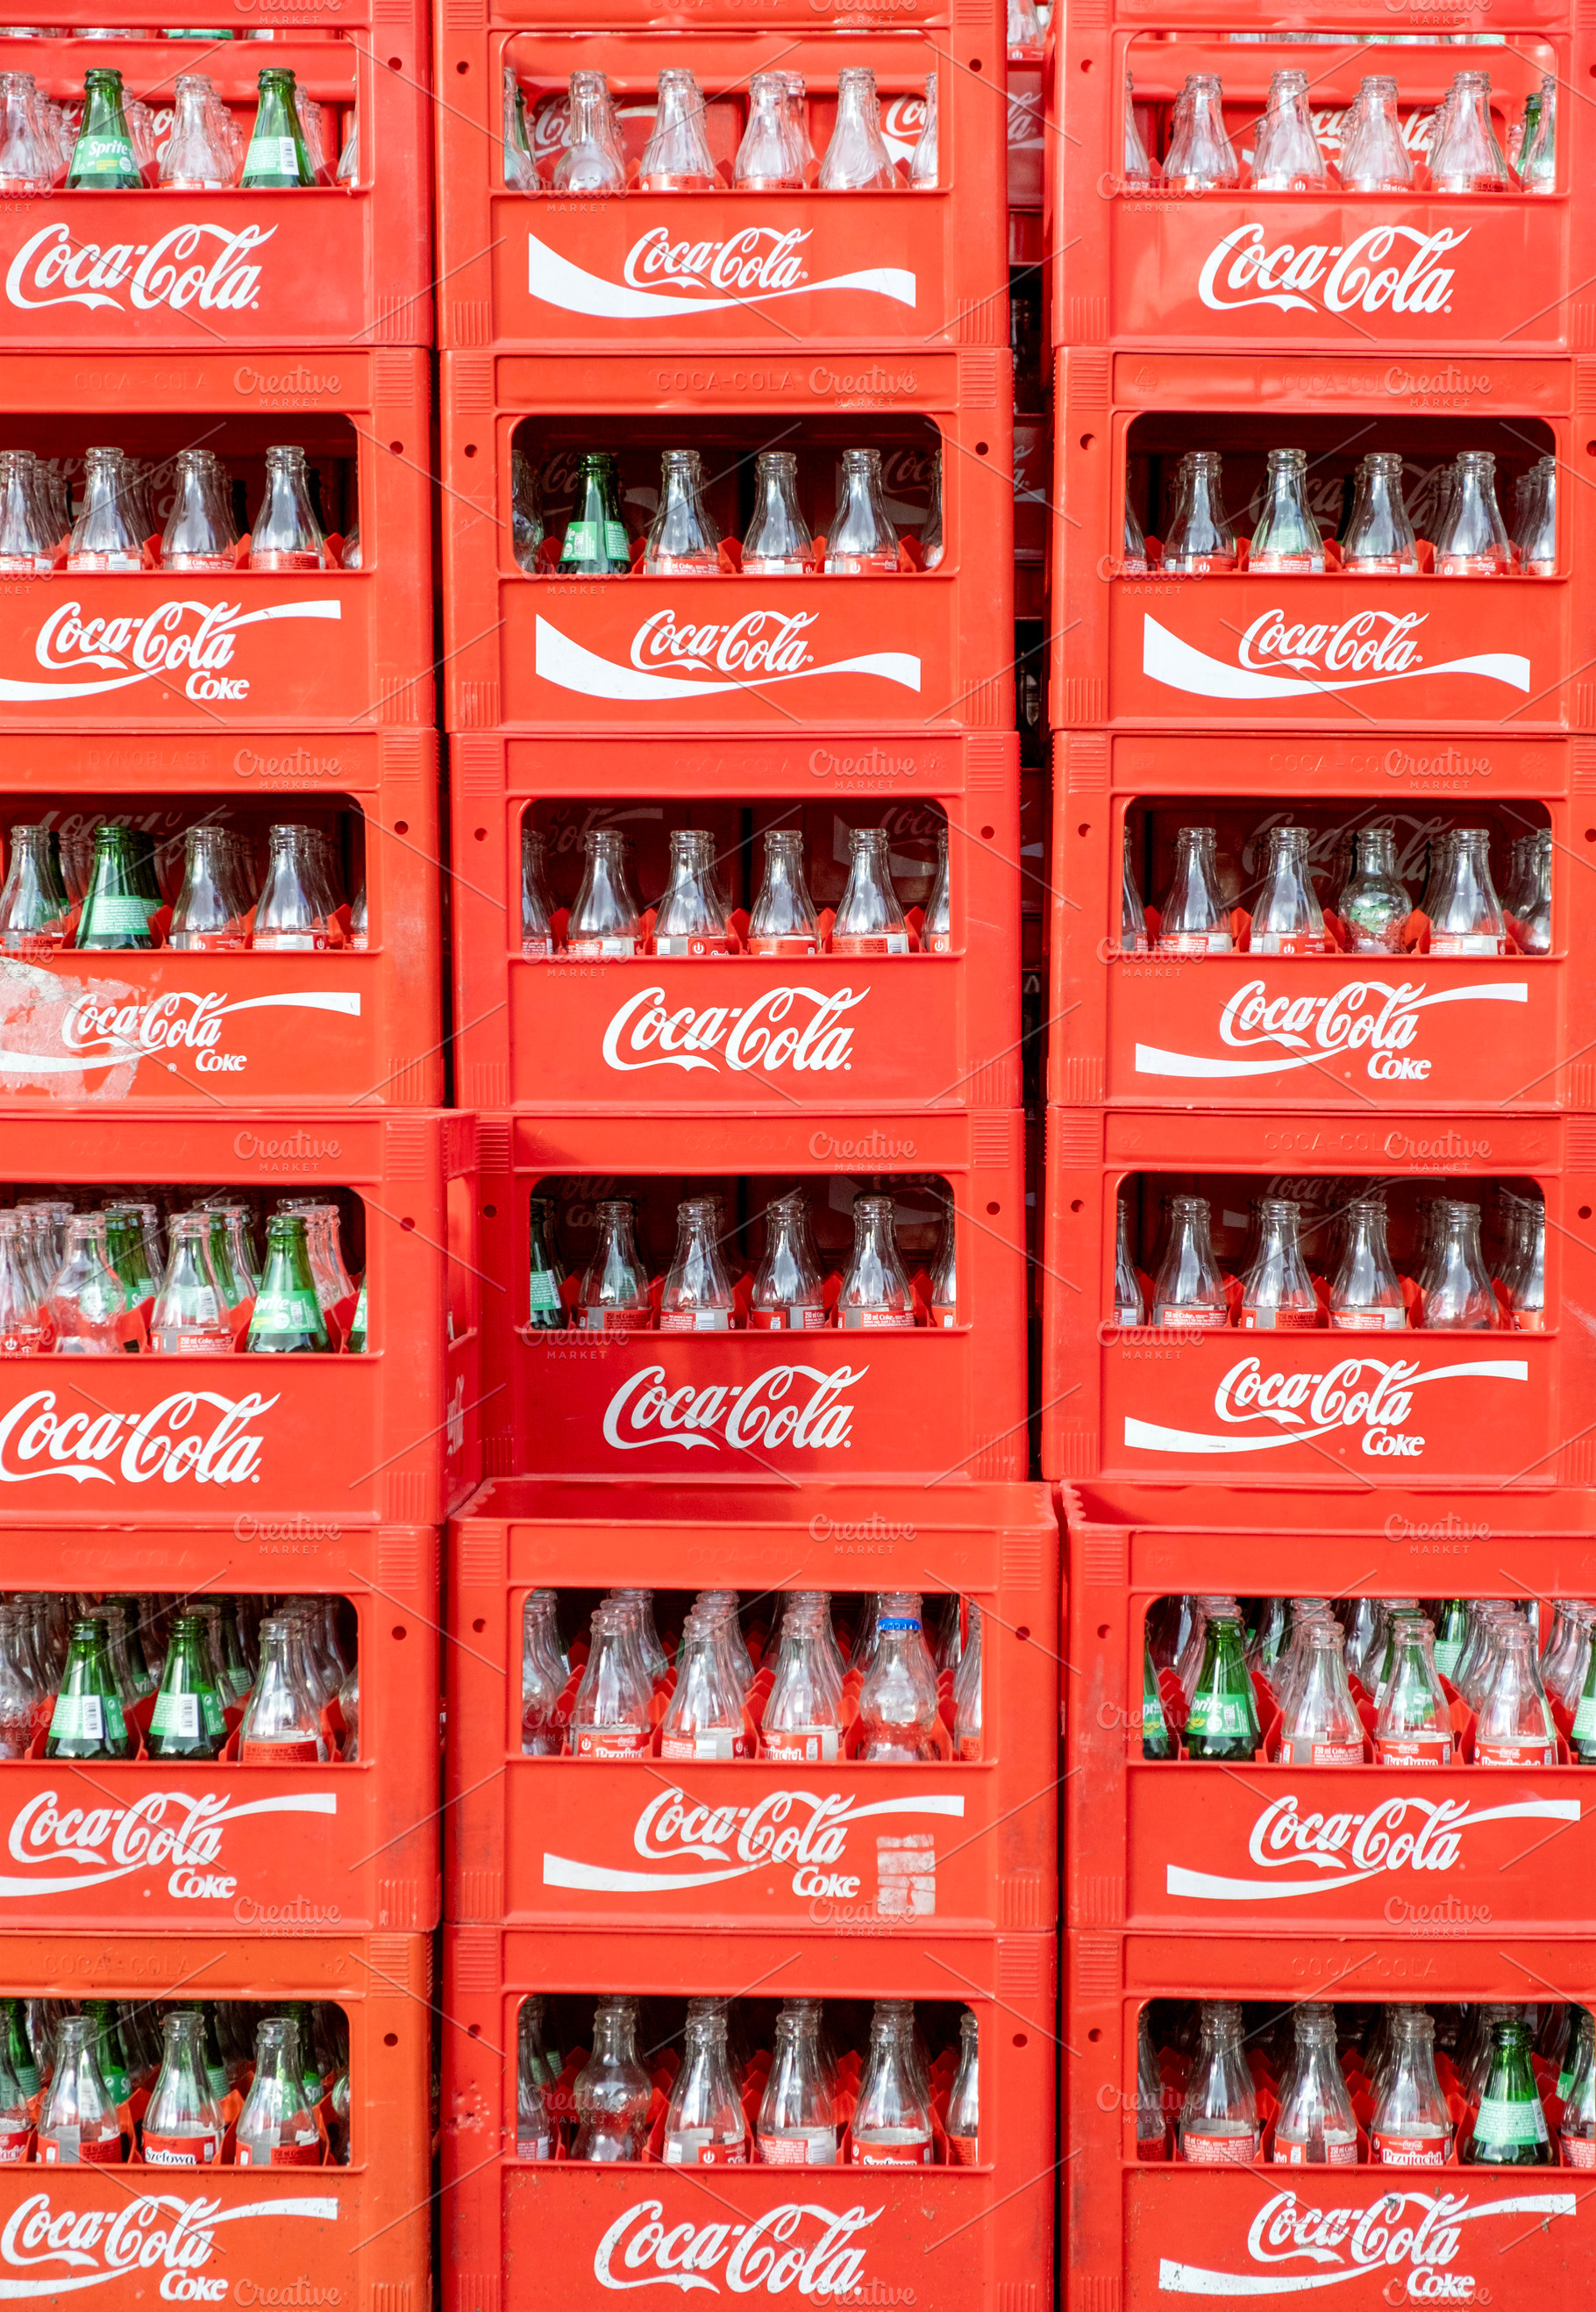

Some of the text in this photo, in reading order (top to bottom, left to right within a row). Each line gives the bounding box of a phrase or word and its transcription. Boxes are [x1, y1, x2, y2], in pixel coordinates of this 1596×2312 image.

[89, 139, 129, 158] Sprite
[656, 371, 796, 392] COCA-COLA
[185, 671, 250, 701] Coke
[195, 1049, 247, 1073] Coke
[1367, 1051, 1431, 1081] Coke
[1361, 1427, 1425, 1458] Coke
[167, 1868, 237, 1899] Coke
[792, 1867, 861, 1898] Coke
[145, 2146, 195, 2166] Szefowa
[1383, 2148, 1443, 2166] Przyjaciel
[160, 2271, 228, 2301] Coke
[1407, 2266, 1476, 2299] Coke
